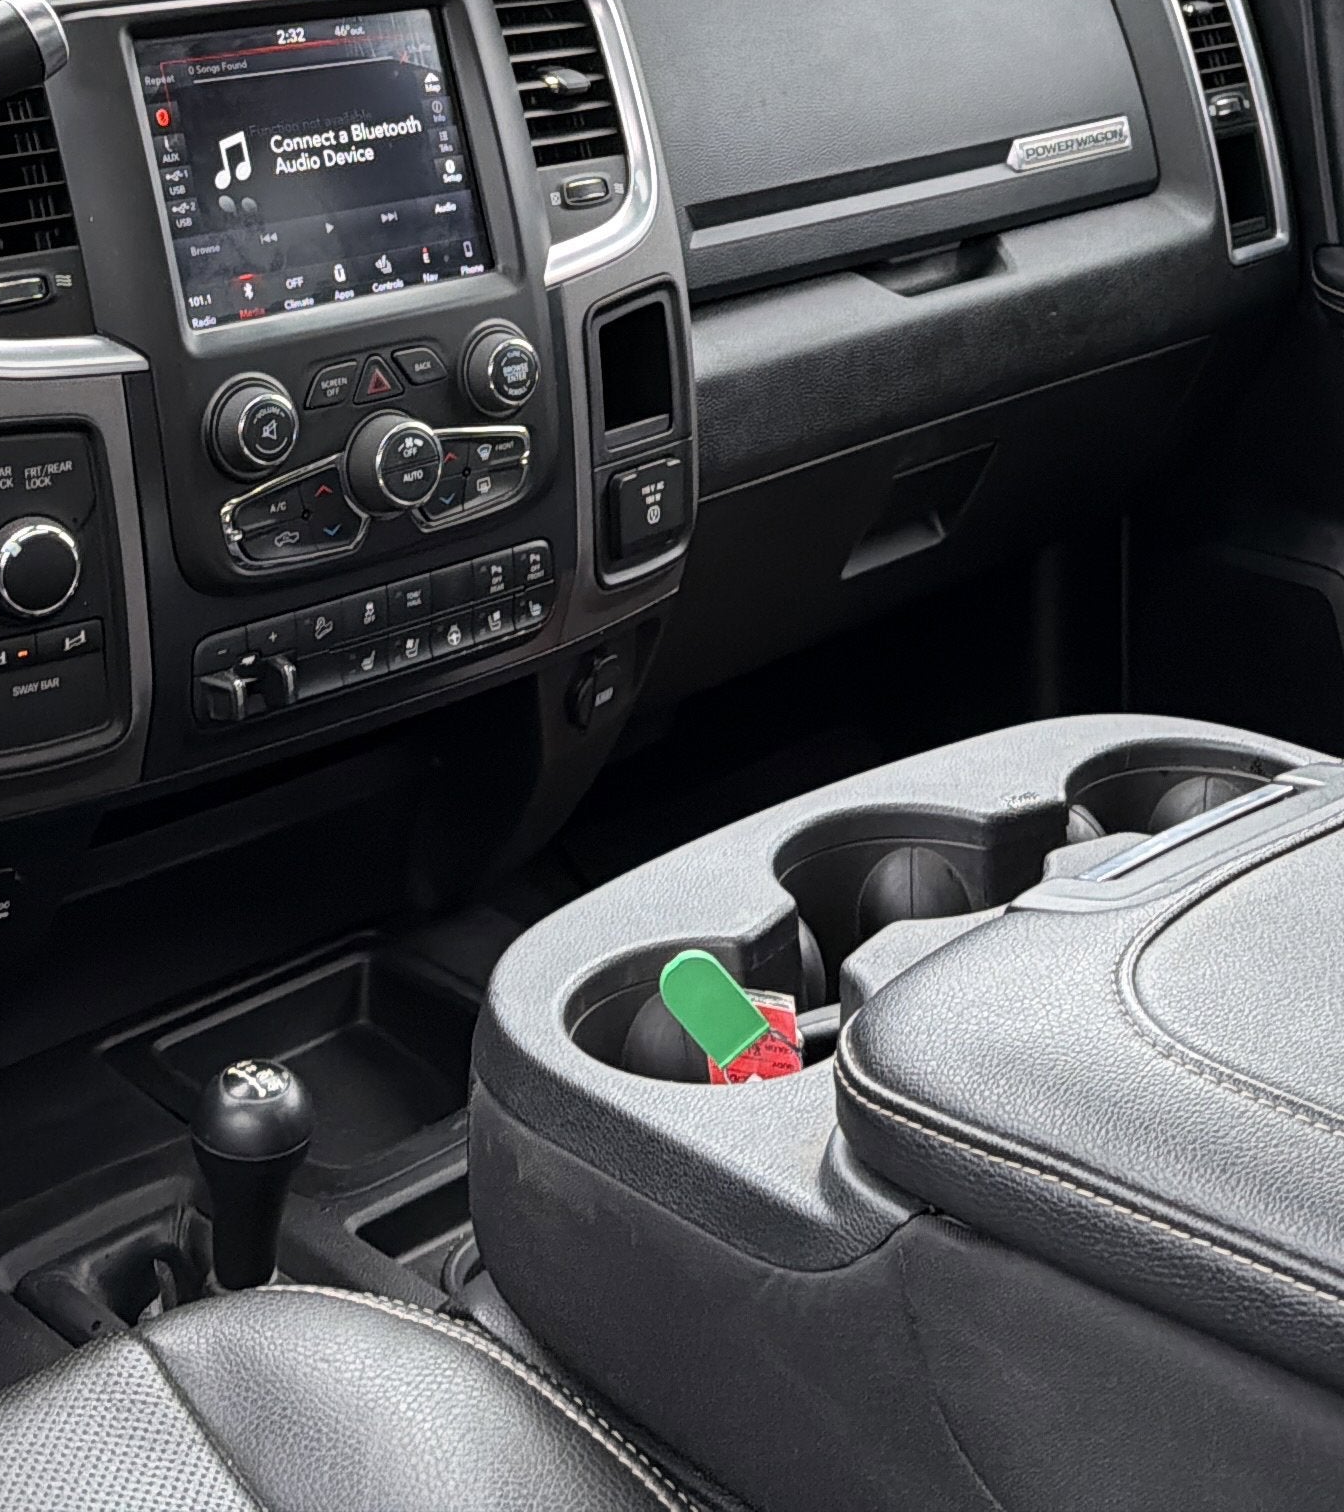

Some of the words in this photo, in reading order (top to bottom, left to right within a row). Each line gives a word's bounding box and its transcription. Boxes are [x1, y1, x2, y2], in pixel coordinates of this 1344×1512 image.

[276, 27, 306, 45] 2:32
[195, 63, 220, 76] Songs
[222, 59, 248, 70] Found
[144, 74, 175, 87] Repeat
[270, 131, 336, 154] Connect
[338, 130, 349, 144] a
[351, 114, 422, 142] Bluetooth
[1024, 139, 1075, 160] POWER
[1077, 128, 1123, 148] WAGON
[162, 152, 180, 164] AUX
[275, 154, 320, 175] Audio
[323, 146, 375, 167] Device
[169, 184, 186, 196] USB
[434, 202, 457, 214] Audio
[176, 217, 192, 228] USB
[190, 243, 221, 257] Browse
[460, 263, 485, 276] Phone
[286, 276, 304, 289] OFF
[422, 272, 438, 284] Nav
[372, 278, 404, 293] Controls
[188, 294, 212, 307] 101.1
[334, 289, 355, 302] Apps
[284, 297, 314, 310] Climate
[239, 307, 266, 320] Media
[191, 315, 217, 329] Radio
[414, 361, 431, 372] BACK
[321, 377, 347, 389] SCREEN
[326, 387, 340, 397] OFF
[403, 447, 418, 458] OFF
[496, 441, 514, 451] FRONT
[24, 460, 72, 479] FRT/REAR
[403, 470, 423, 482] AUTO
[25, 476, 52, 490] LOCK
[270, 501, 287, 513] A/C
[12, 681, 39, 697] SWAY
[41, 677, 60, 691] BAR
